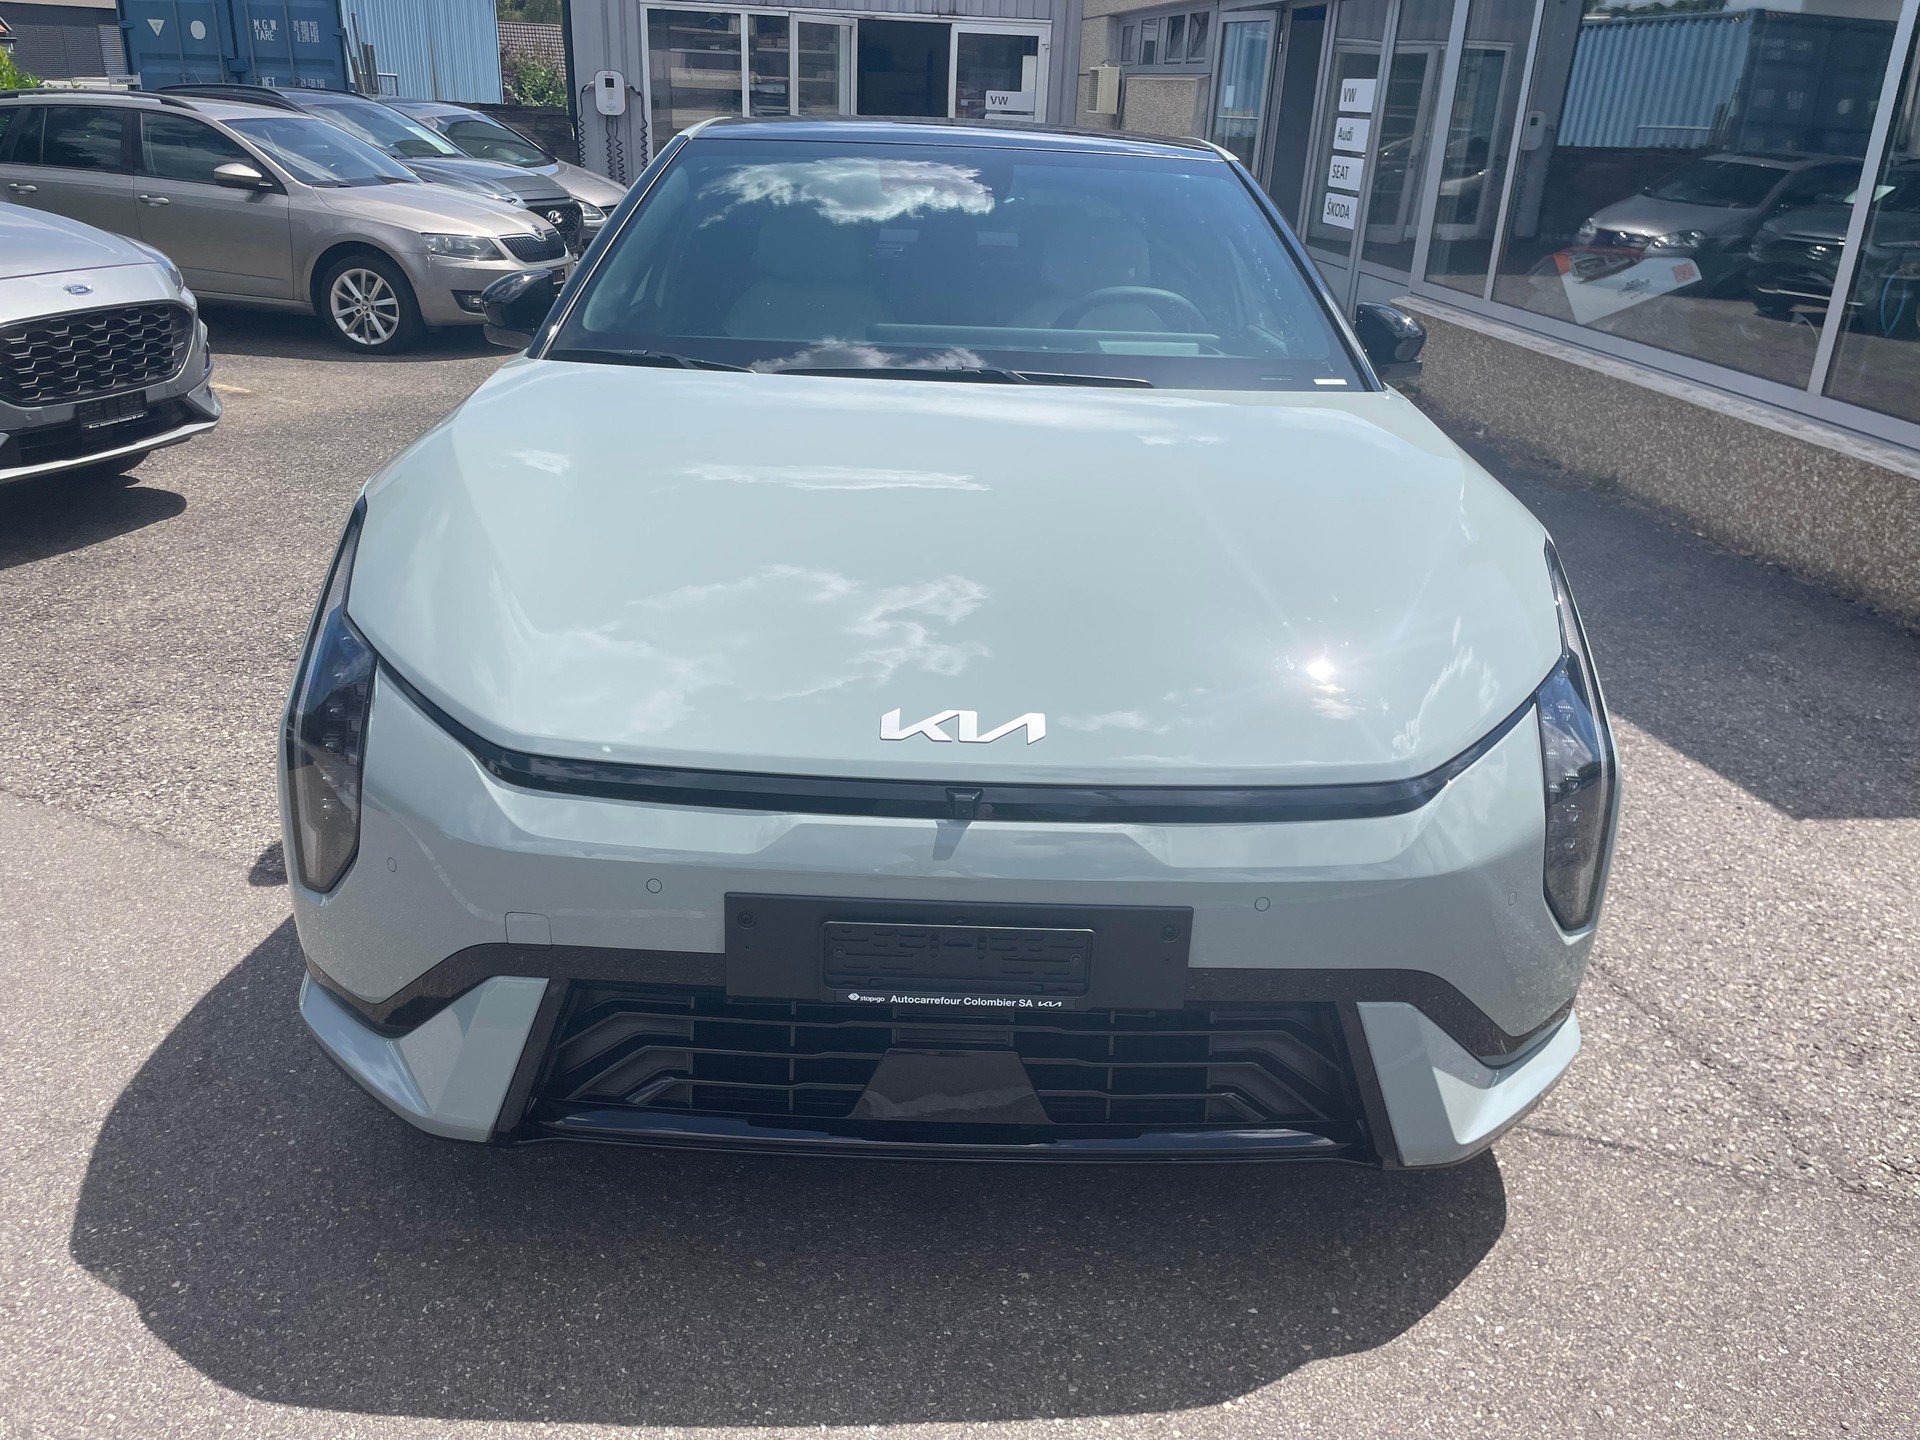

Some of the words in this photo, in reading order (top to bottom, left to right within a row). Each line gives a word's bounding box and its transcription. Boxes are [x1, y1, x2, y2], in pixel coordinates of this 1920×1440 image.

[253, 19, 279, 31] M.G.W.
[255, 29, 275, 41] TARE
[262, 77, 275, 88] NET
[990, 95, 1009, 106] VW
[1343, 87, 1357, 103] VW
[1337, 127, 1354, 142] Audi
[1331, 164, 1350, 180] SEAT
[1326, 198, 1350, 220] ŠKODA
[880, 707, 1046, 746] KIA
[890, 994, 961, 1006] Autocarrefour
[963, 997, 1016, 1007] Colombier
[1018, 999, 1033, 1008] SA
